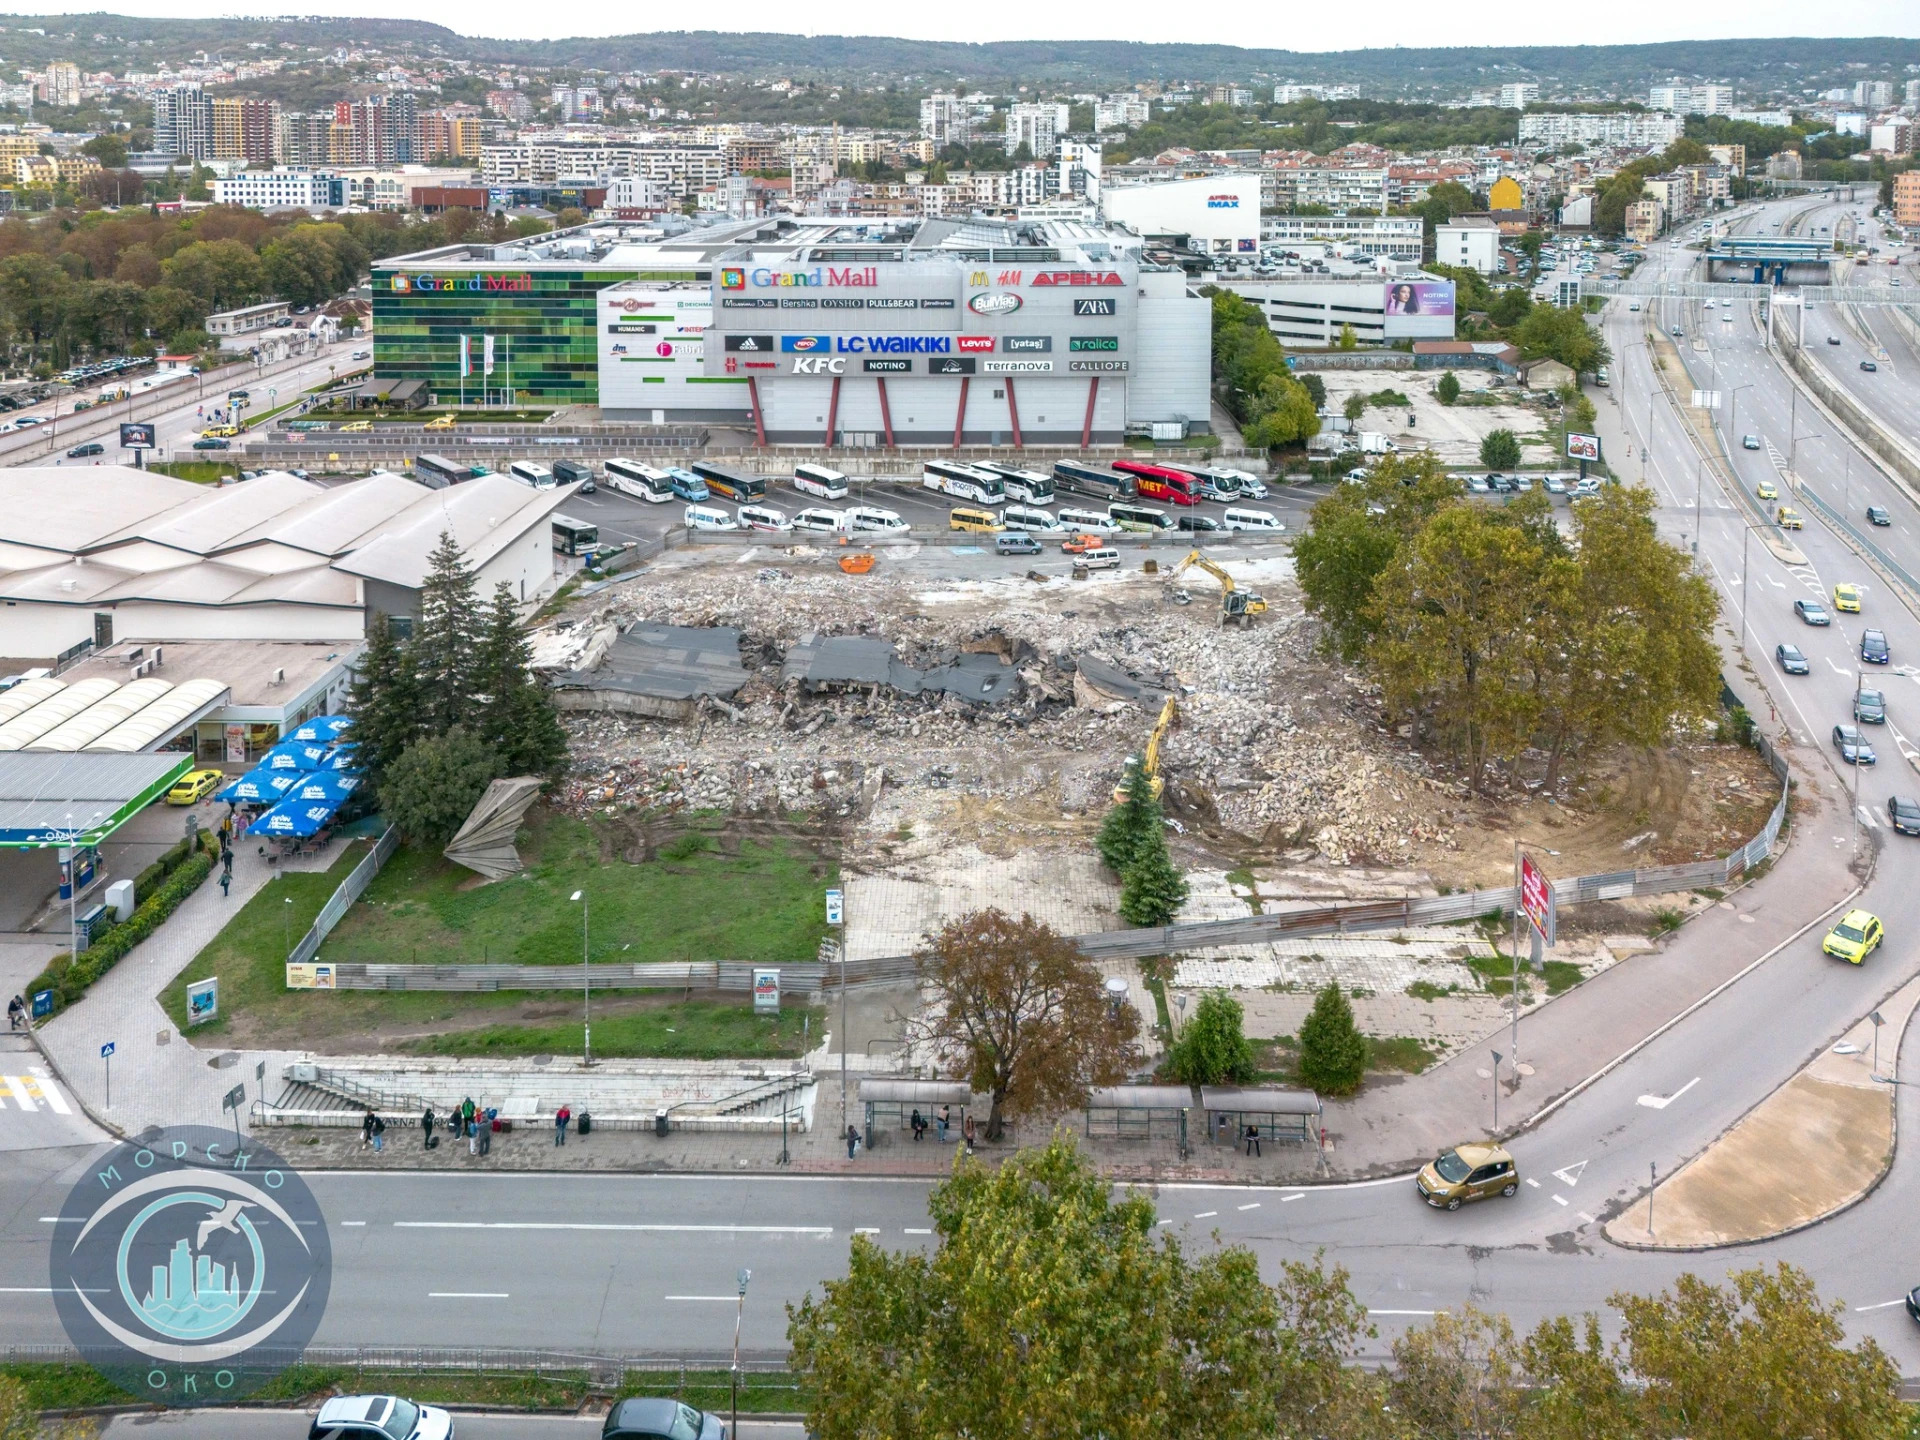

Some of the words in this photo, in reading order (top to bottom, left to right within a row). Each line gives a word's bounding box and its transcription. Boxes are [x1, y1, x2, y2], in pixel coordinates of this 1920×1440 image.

[416, 273, 481, 291] Grand
[487, 274, 532, 291] Mall
[751, 267, 822, 287] Grand
[828, 267, 878, 286] Mall
[1031, 273, 1124, 285] АРЕНА
[783, 300, 816, 308] Bershka
[823, 300, 861, 308] OYSHO
[1078, 301, 1109, 314] ZARA
[837, 336, 865, 353] LC
[791, 357, 847, 374] KFC
[869, 362, 906, 370] NOTINO
[1071, 362, 1128, 370] CALLIOPE
